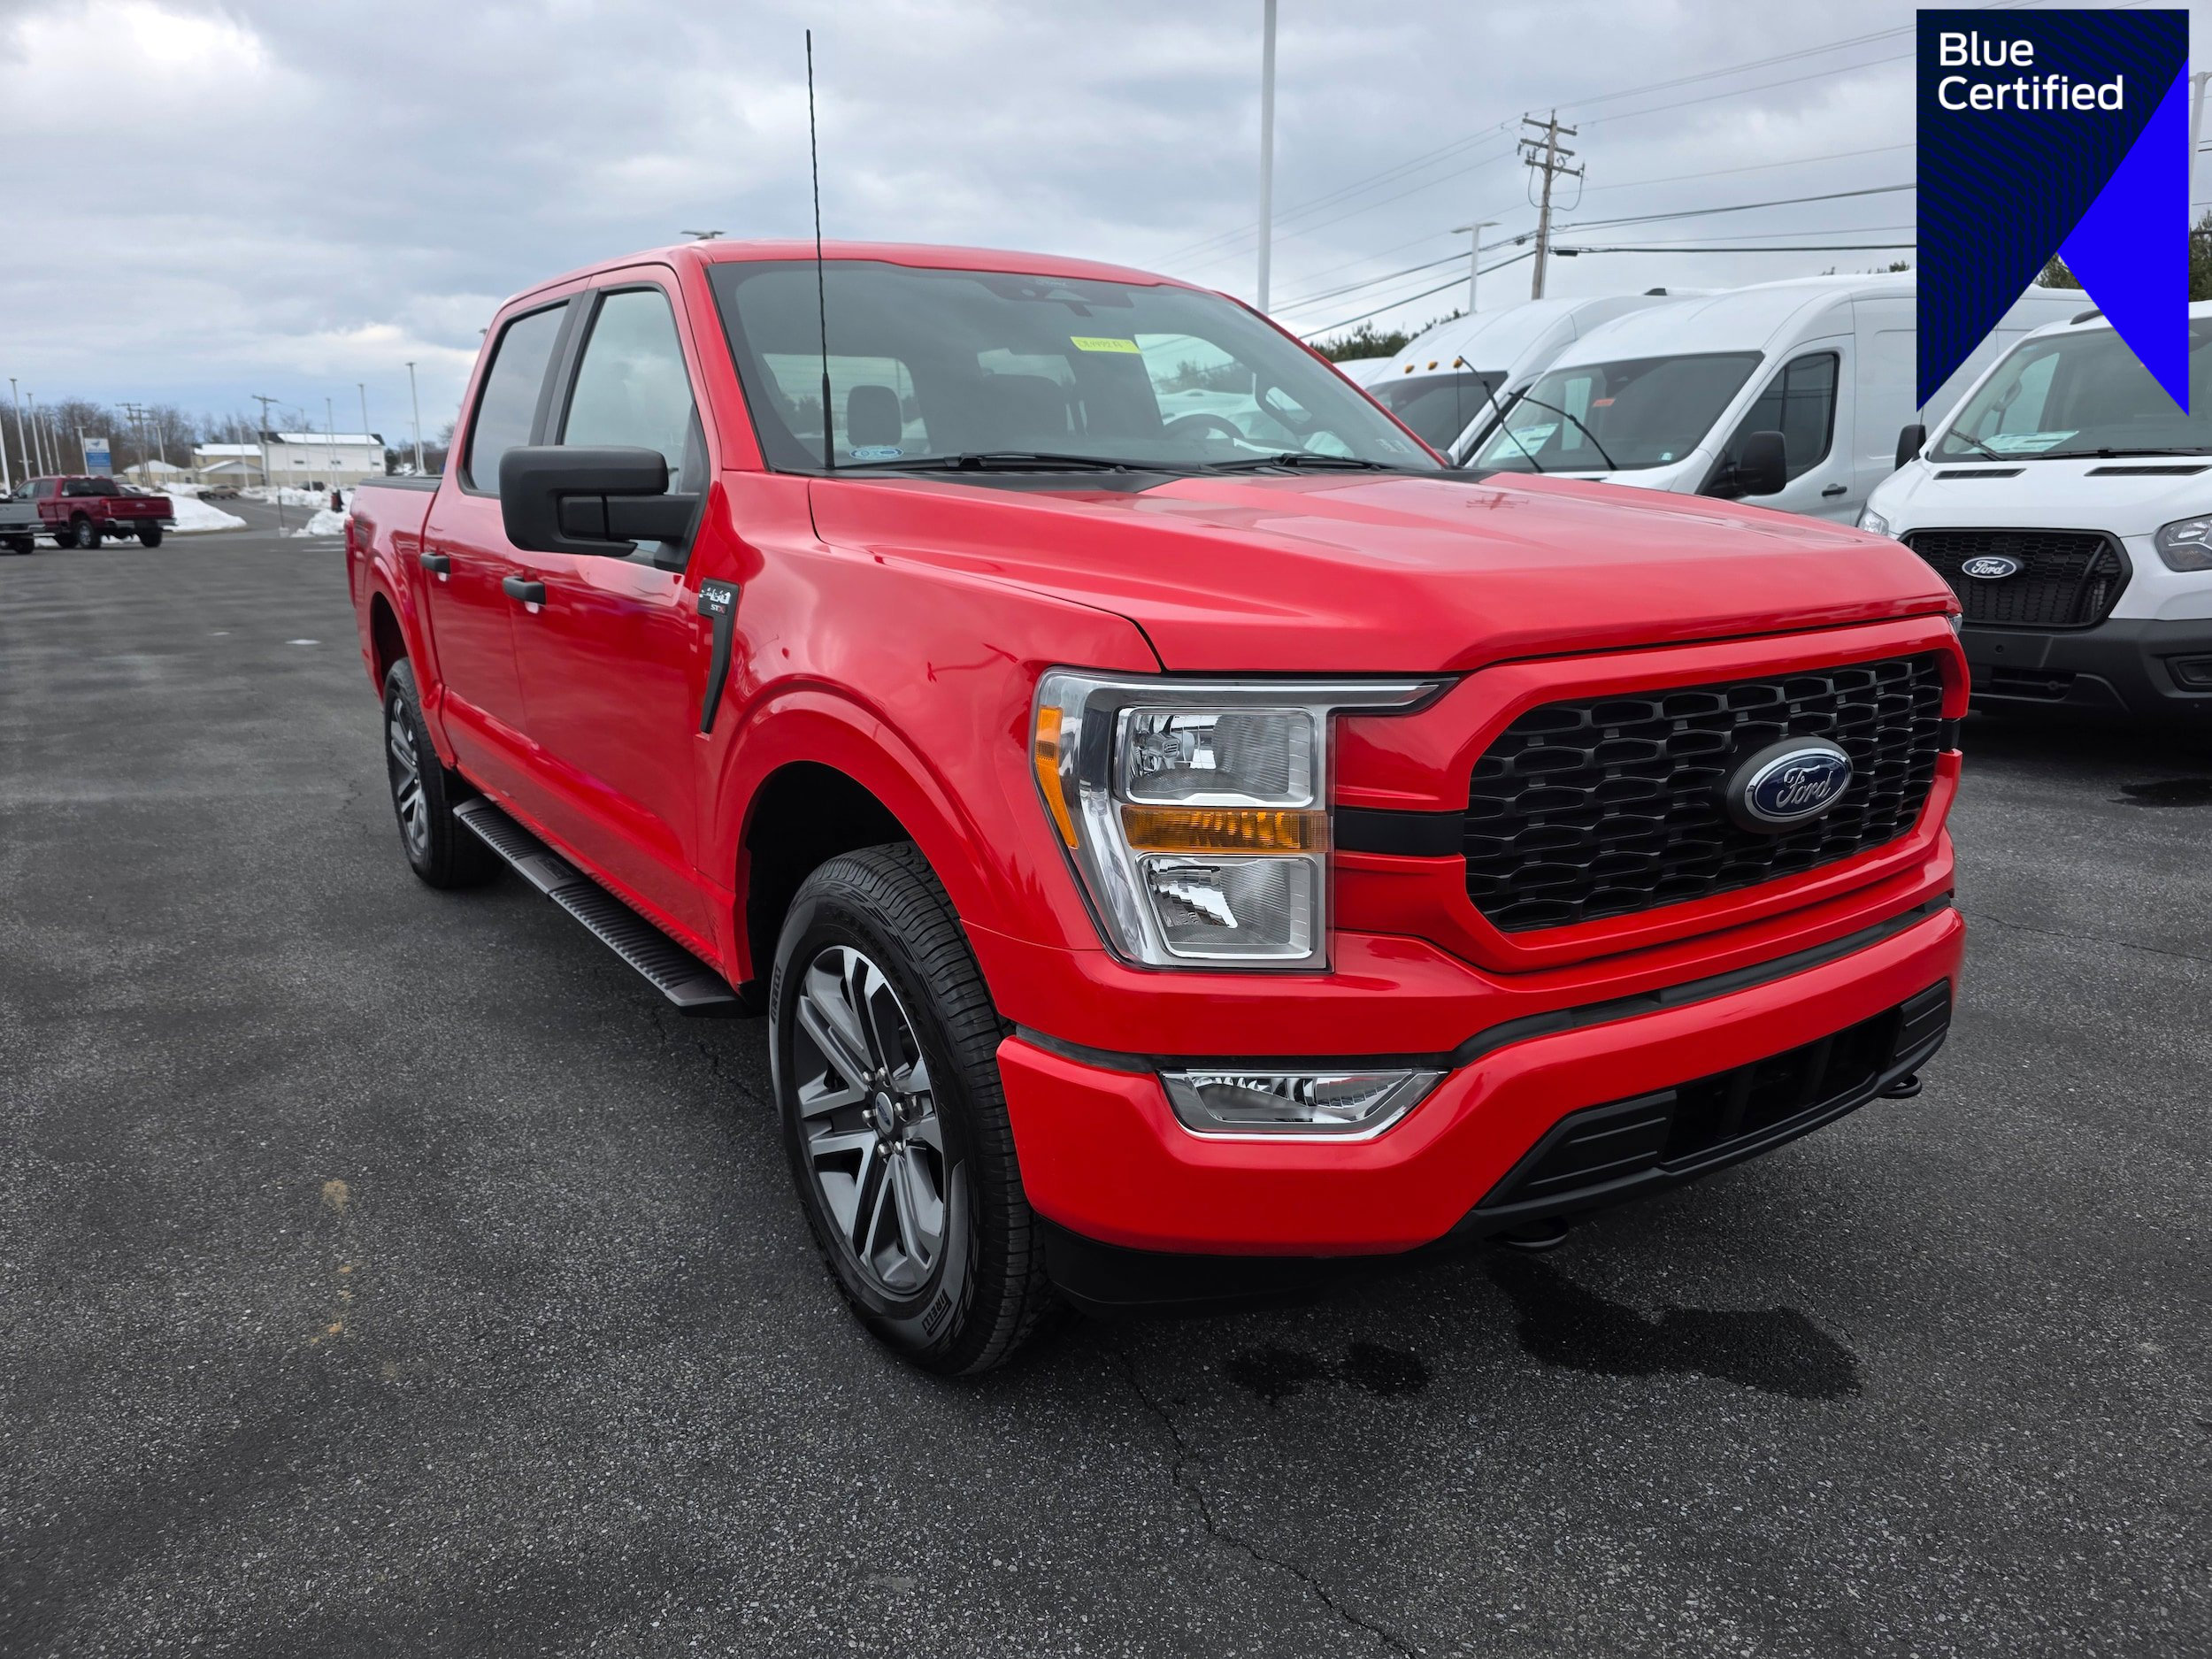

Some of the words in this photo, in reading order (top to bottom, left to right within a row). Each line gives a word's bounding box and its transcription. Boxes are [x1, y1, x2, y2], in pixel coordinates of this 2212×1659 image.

[1971, 559, 2007, 574] Ford
[710, 603, 726, 614] STX
[1776, 764, 1834, 809] Ford
